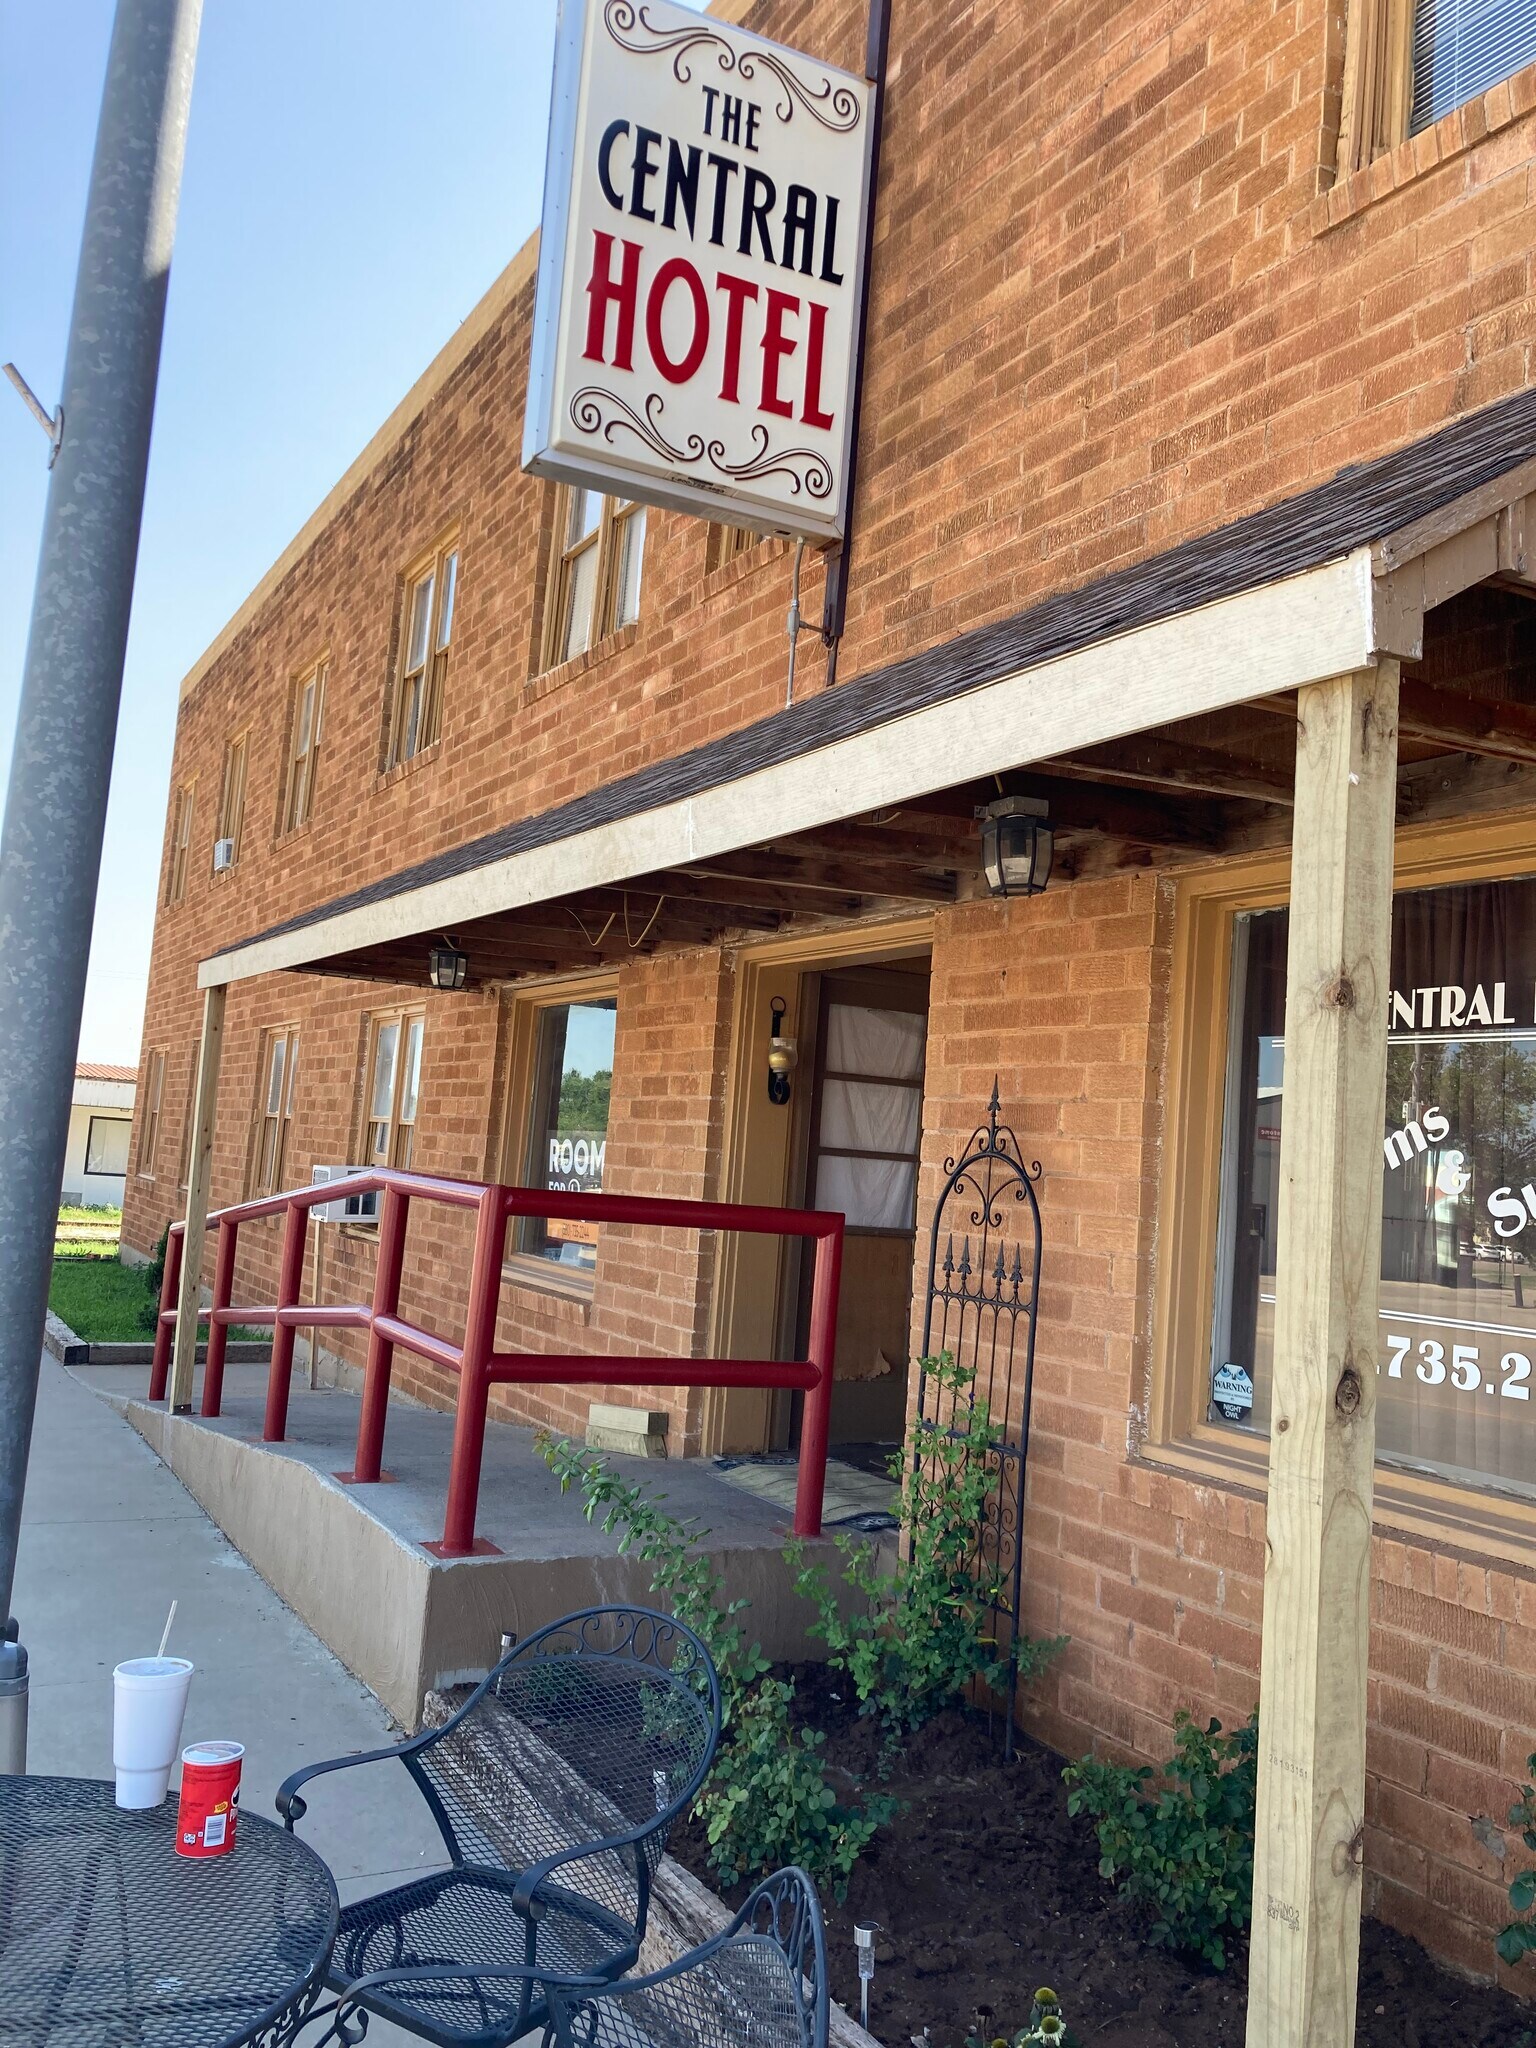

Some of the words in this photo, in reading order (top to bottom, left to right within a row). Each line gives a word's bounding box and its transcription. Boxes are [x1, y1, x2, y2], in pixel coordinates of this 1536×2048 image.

[701, 85, 762, 153] THE
[597, 118, 846, 287] CENTRAL
[581, 228, 835, 432] HOTEL
[1387, 981, 1515, 1030] NTRAL
[1383, 1106, 1450, 1171] ms
[1436, 1150, 1472, 1196] &
[1214, 1380, 1252, 1394] WARNING
[1223, 1403, 1242, 1413] NIGHT
[1225, 1410, 1239, 1419] OWL
